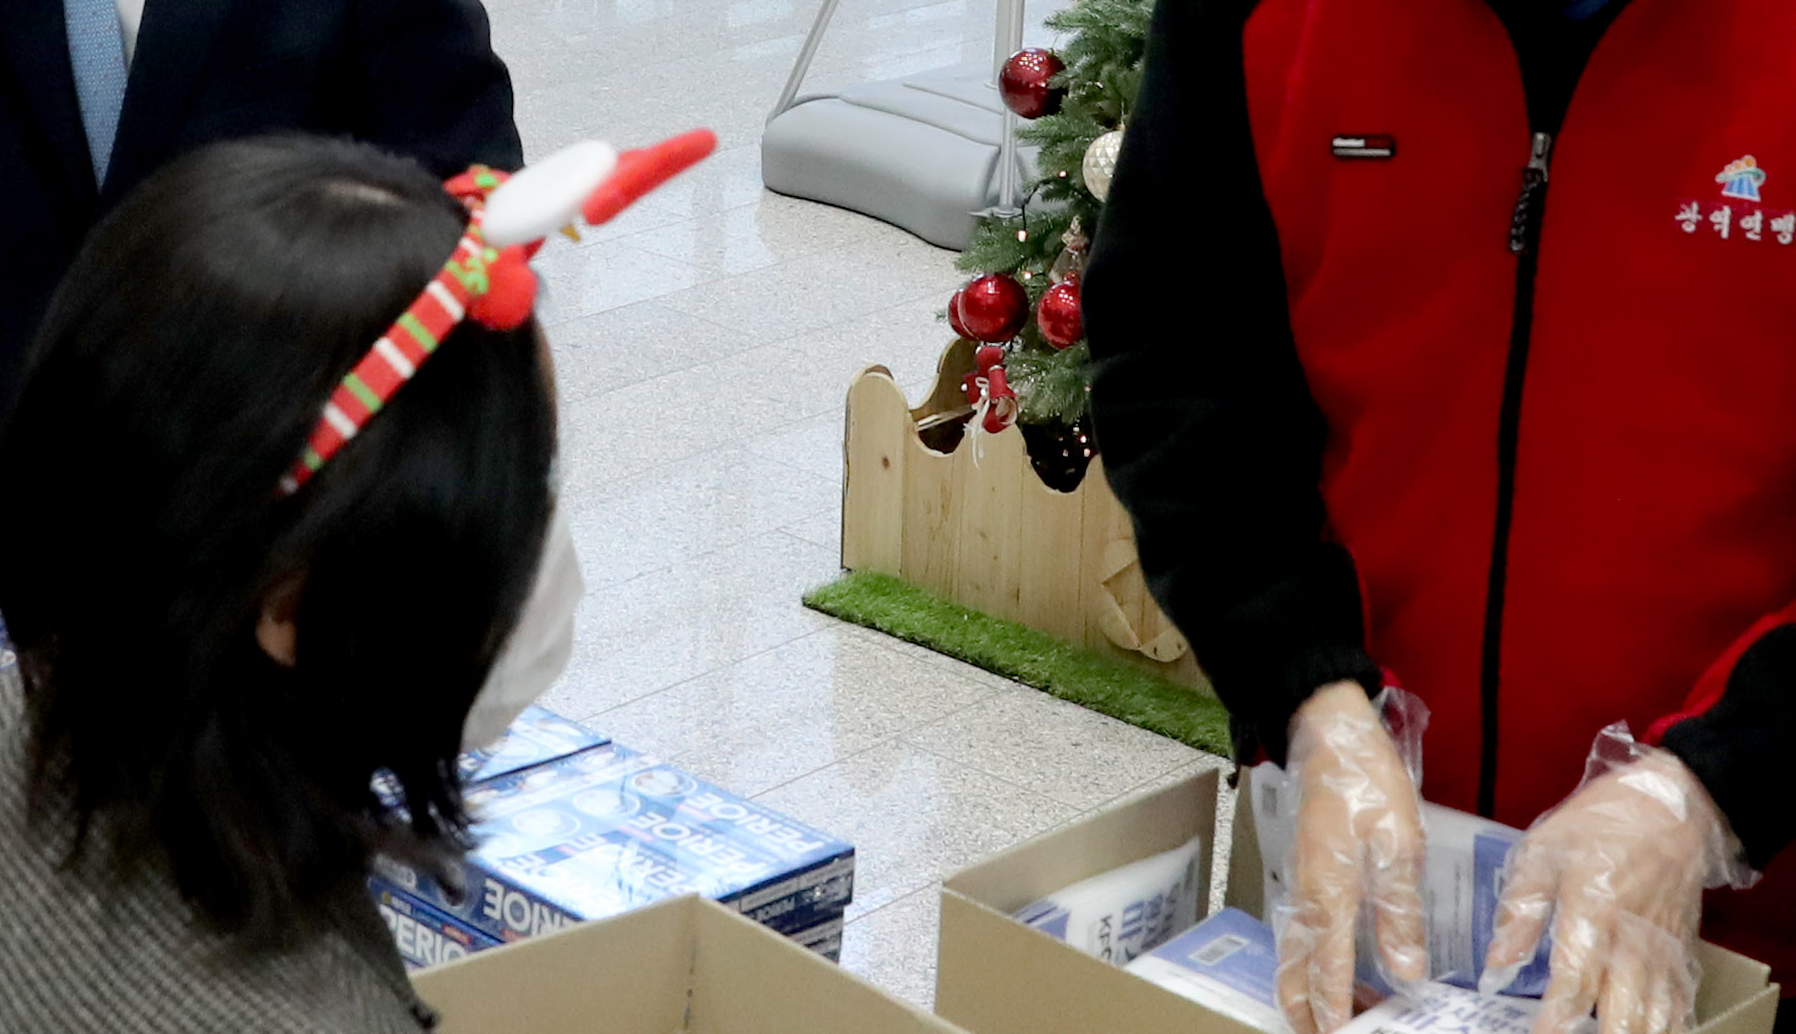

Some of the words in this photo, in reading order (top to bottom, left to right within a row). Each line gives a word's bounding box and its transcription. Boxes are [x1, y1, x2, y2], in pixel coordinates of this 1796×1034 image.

[628, 811, 766, 872] PERIOE
[687, 792, 825, 853] PERIOE
[380, 904, 468, 964] PERIO
